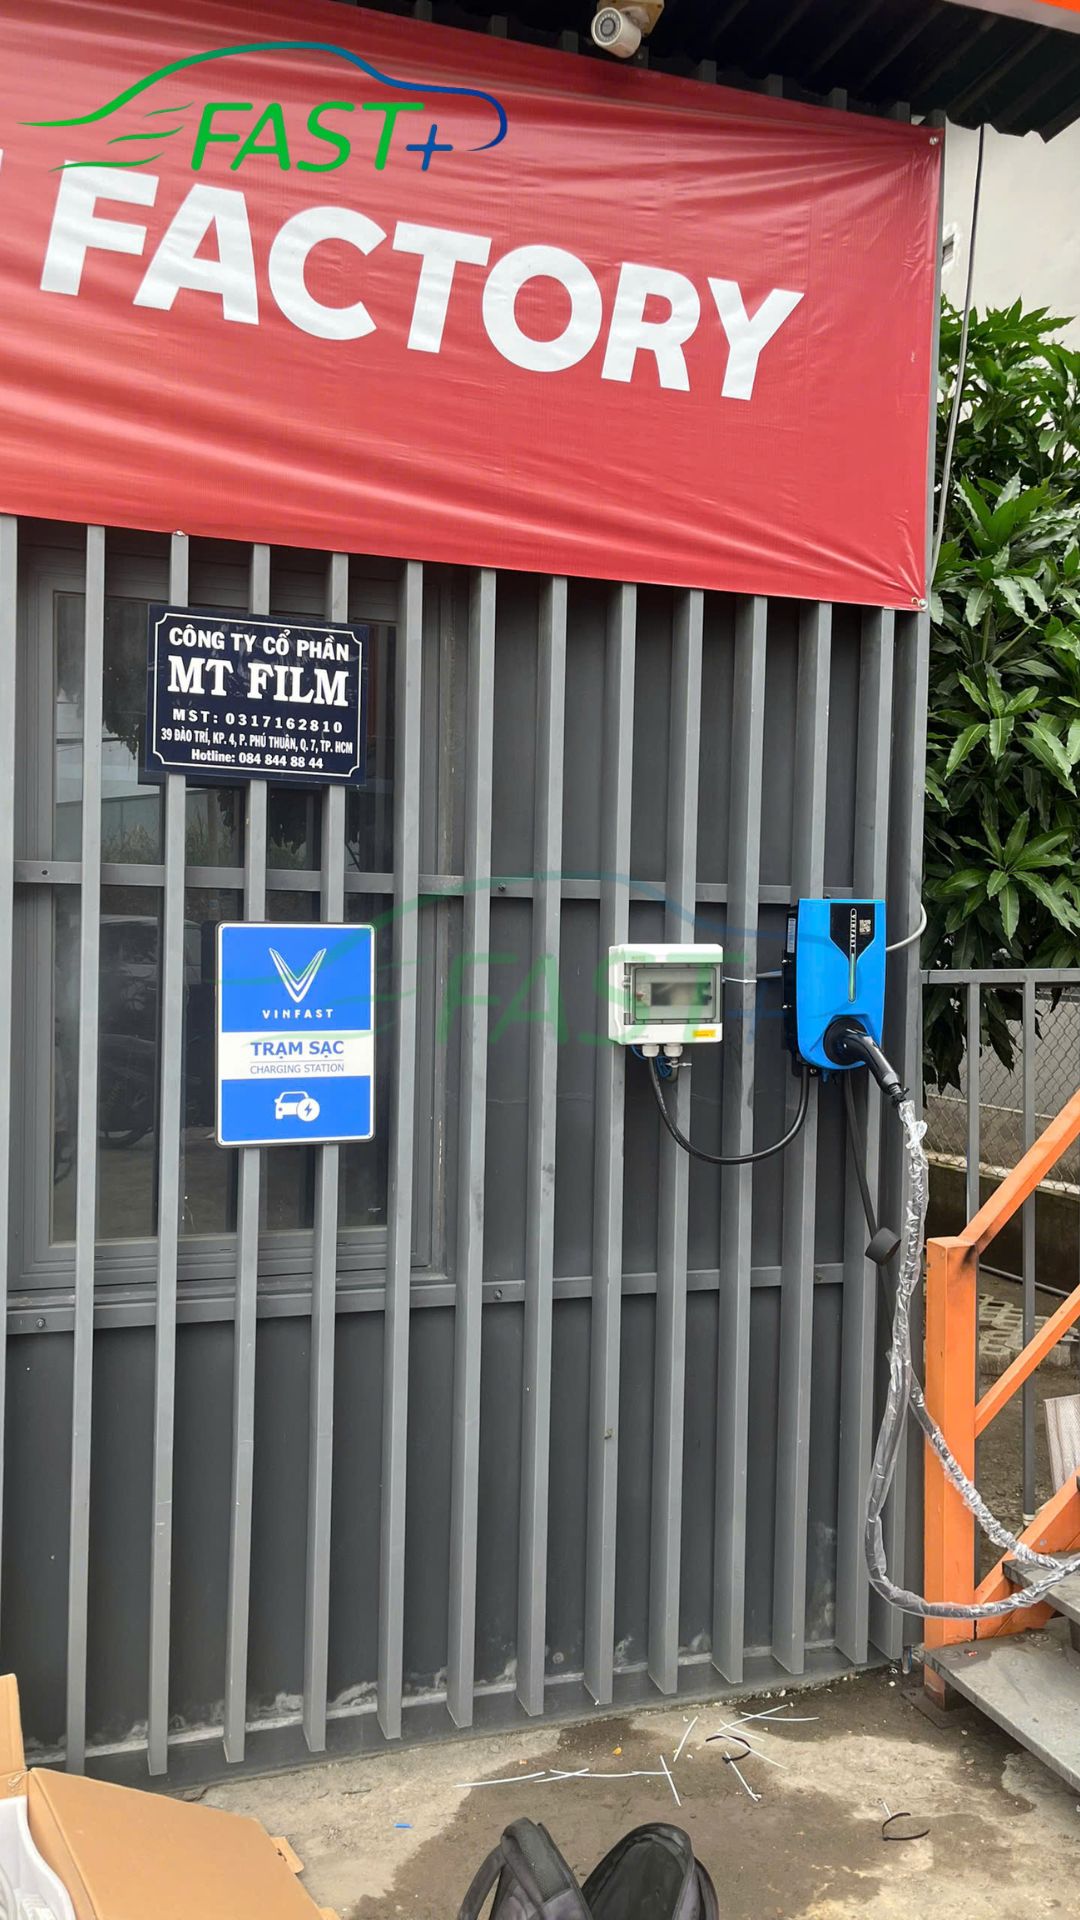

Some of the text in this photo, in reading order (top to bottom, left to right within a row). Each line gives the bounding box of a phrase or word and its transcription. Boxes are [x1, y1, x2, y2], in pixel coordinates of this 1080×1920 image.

[40, 160, 805, 401] FACTORY
[169, 624, 349, 662] CÔNG TY CỔ PHẦN
[167, 655, 349, 707] MT FILM
[172, 708, 343, 734] MST: 0317162810
[161, 726, 353, 754] 39 ĐÀO TRÍ, KP. 4, P. PHÚ THUẬN, Q. 7, TP. HCM
[191, 749, 324, 769] Hotline: 084 844 88 44
[262, 1009, 334, 1019] VINFAST
[250, 1041, 344, 1059] TRẠM SẠC
[250, 1063, 345, 1074] CHARGING STATION
